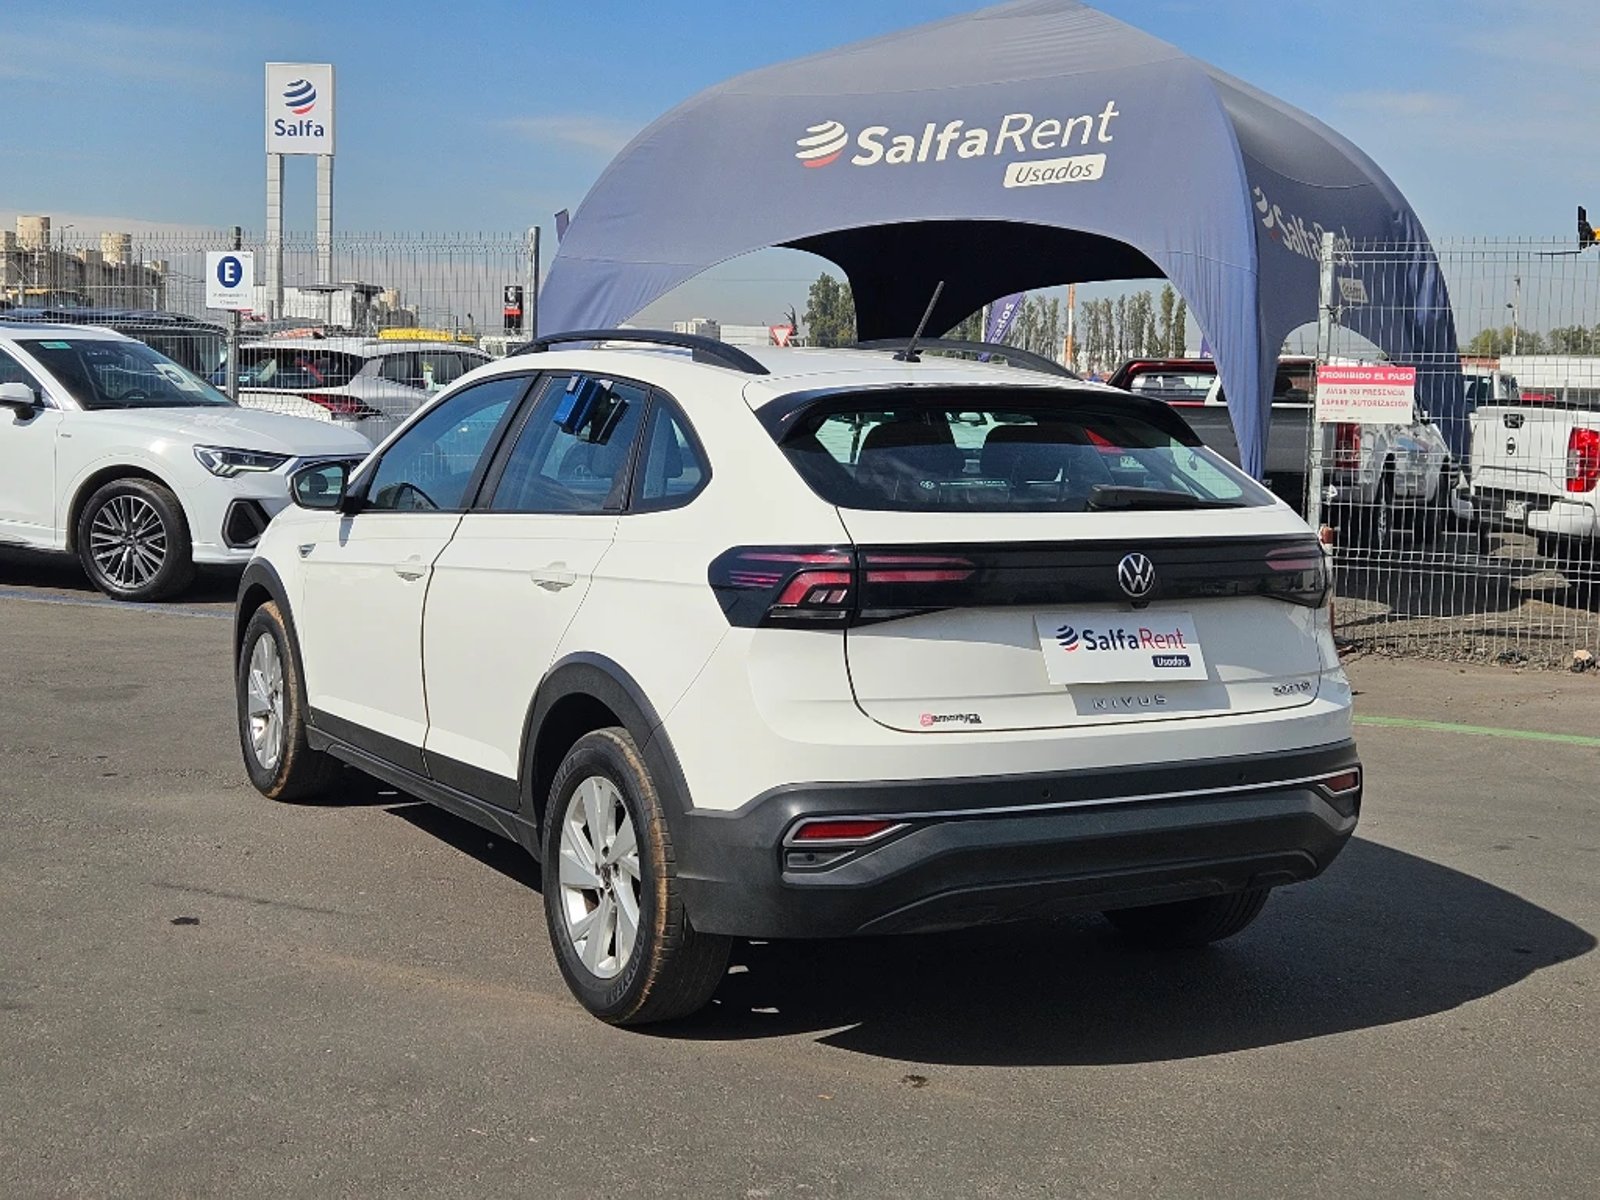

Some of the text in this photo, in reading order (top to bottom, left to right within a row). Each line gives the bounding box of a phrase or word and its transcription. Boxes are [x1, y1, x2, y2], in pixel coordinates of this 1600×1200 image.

[274, 118, 325, 137] Salfa
[851, 100, 1120, 165] SalfaRent
[1015, 160, 1094, 184] Usados
[224, 261, 235, 282] E
[1320, 371, 1414, 381] PROHIBIDO EL PASO
[1082, 627, 1187, 651] SalfaRent
[1157, 656, 1187, 667] Usados
[1092, 694, 1168, 710] NIVUS
